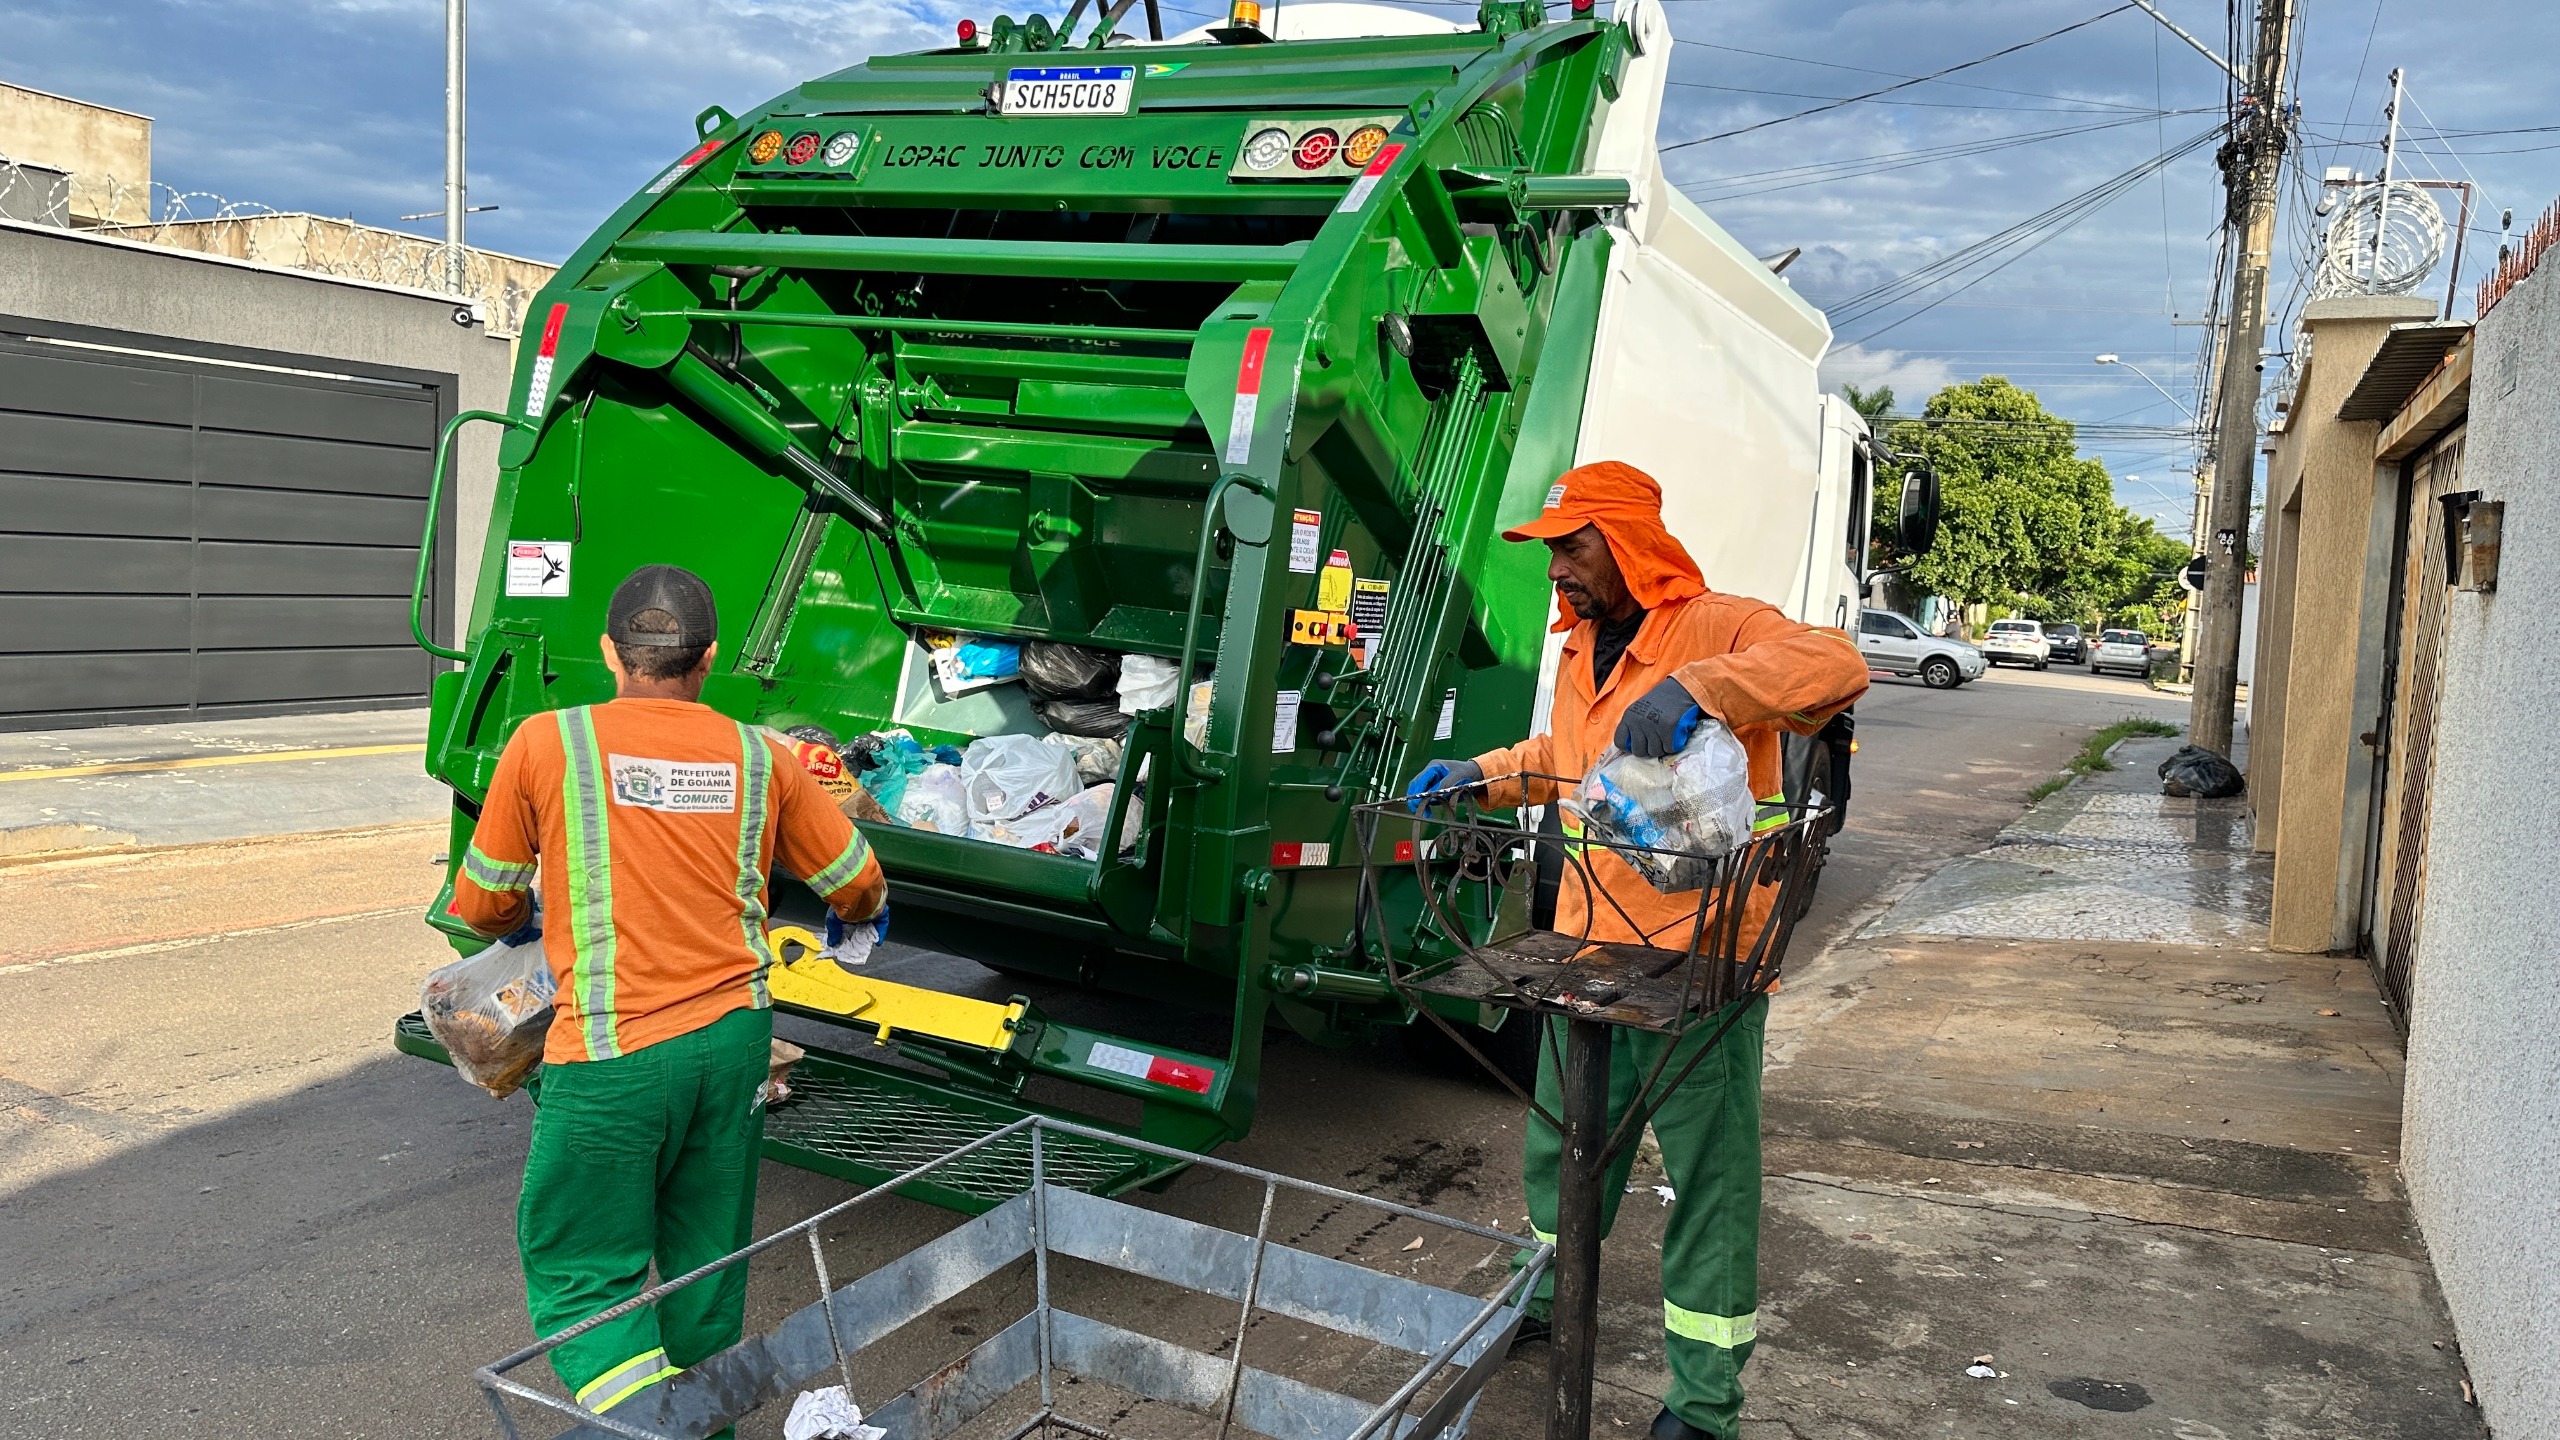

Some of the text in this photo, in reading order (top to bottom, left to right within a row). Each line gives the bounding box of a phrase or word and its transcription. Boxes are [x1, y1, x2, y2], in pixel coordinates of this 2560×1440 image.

[1015, 83, 1116, 109] SCH5C08
[883, 145, 1226, 169] LOPAC JUNTO COM VOCE
[671, 768, 731, 777] PREFEITURA
[671, 778, 731, 787] DE GOIÂNIA
[672, 793, 729, 804] COMURG
